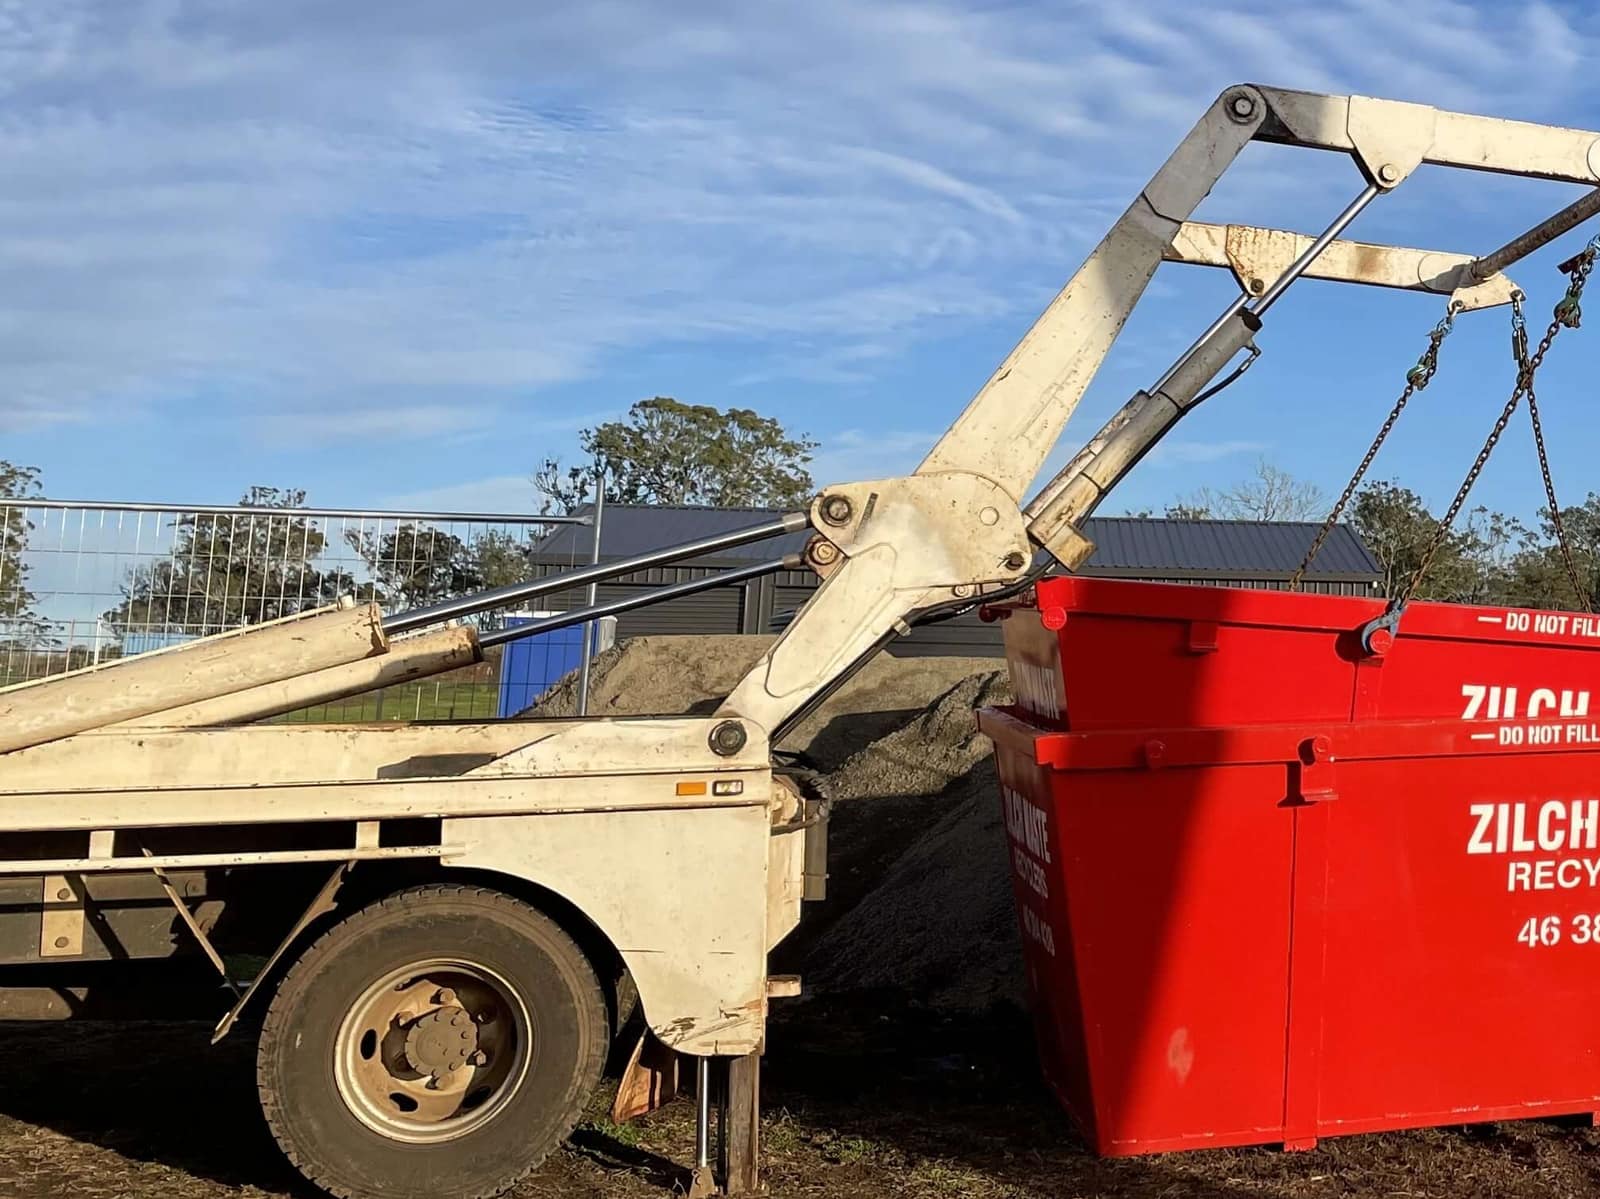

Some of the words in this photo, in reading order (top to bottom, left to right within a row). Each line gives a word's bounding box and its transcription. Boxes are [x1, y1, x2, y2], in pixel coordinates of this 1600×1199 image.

[1505, 612, 1530, 632] DO
[1534, 614, 1569, 635] NOT
[1499, 725, 1524, 745] DO
[1527, 724, 1563, 745] NOT
[1566, 723, 1600, 743] FILL
[1467, 799, 1599, 854] ZILCH
[1517, 915, 1561, 947] 46
